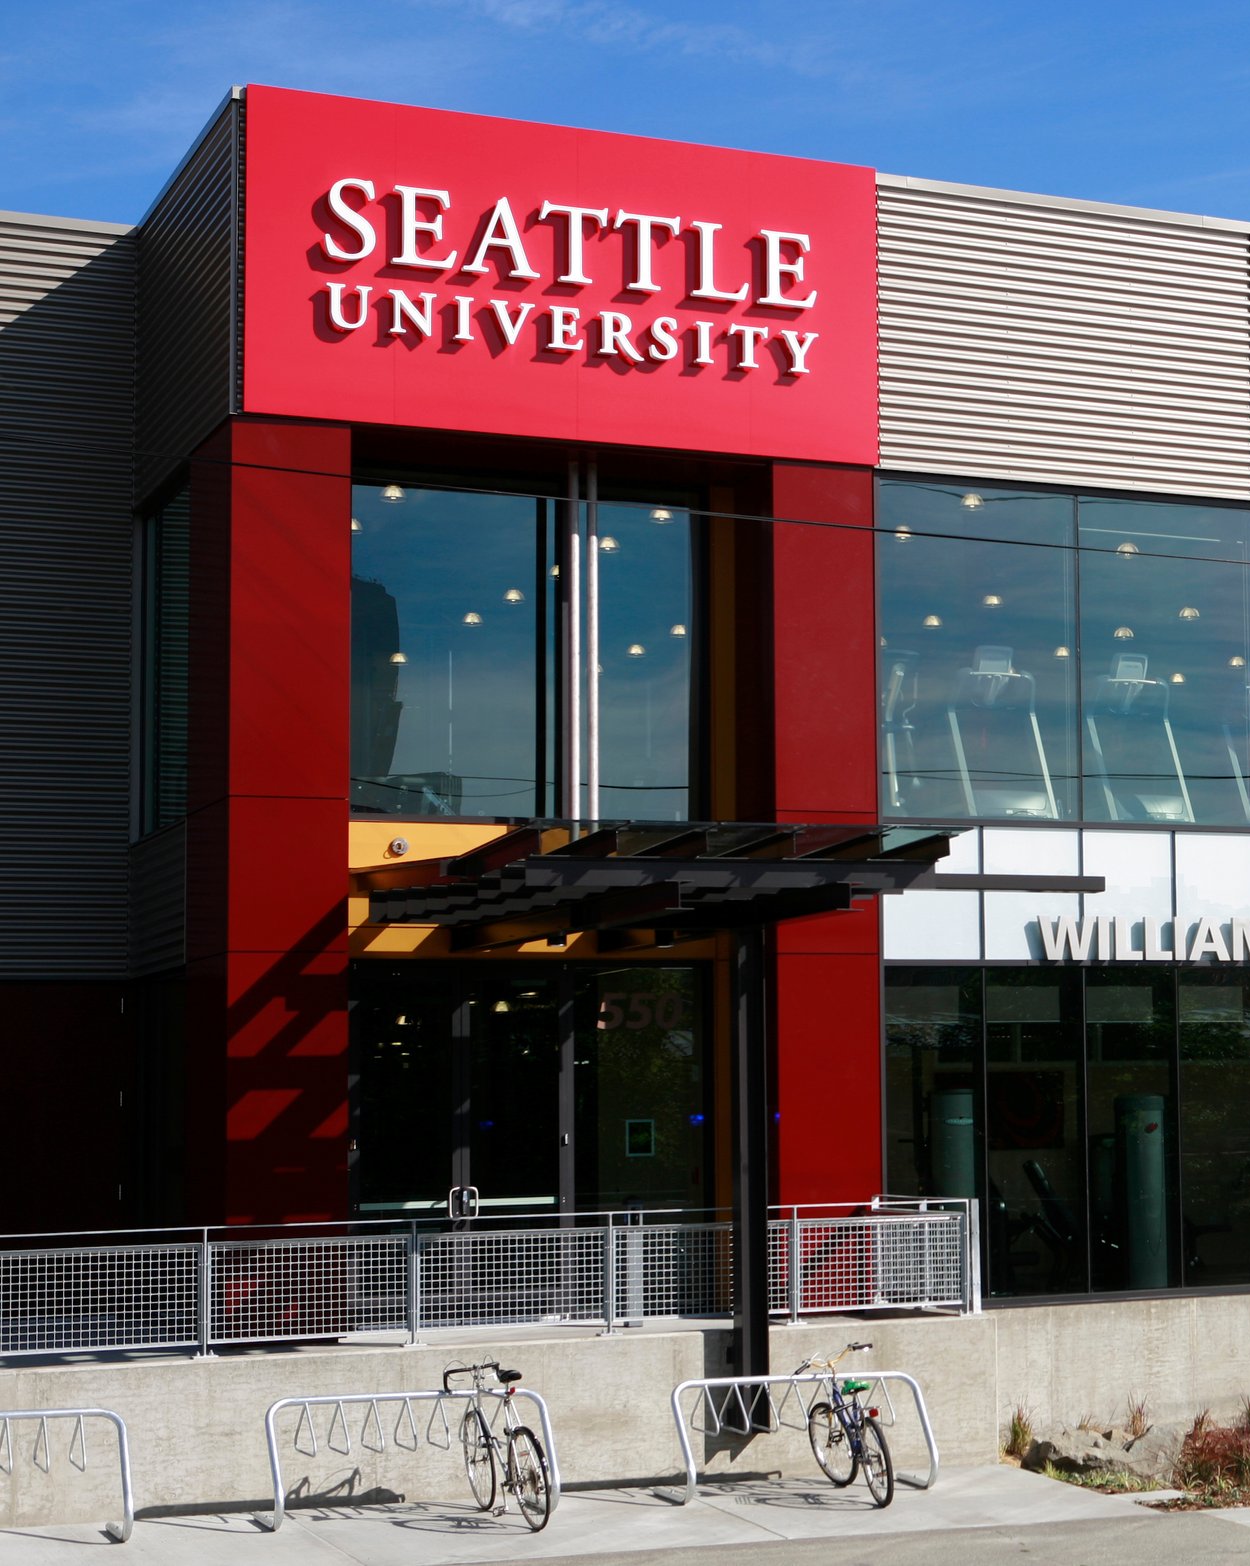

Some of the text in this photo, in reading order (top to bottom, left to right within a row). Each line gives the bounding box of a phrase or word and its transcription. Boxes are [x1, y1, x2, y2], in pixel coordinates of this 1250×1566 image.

[324, 178, 818, 308] SEATTLE
[326, 282, 819, 374] UNIVERSITY
[597, 992, 682, 1029] 550
